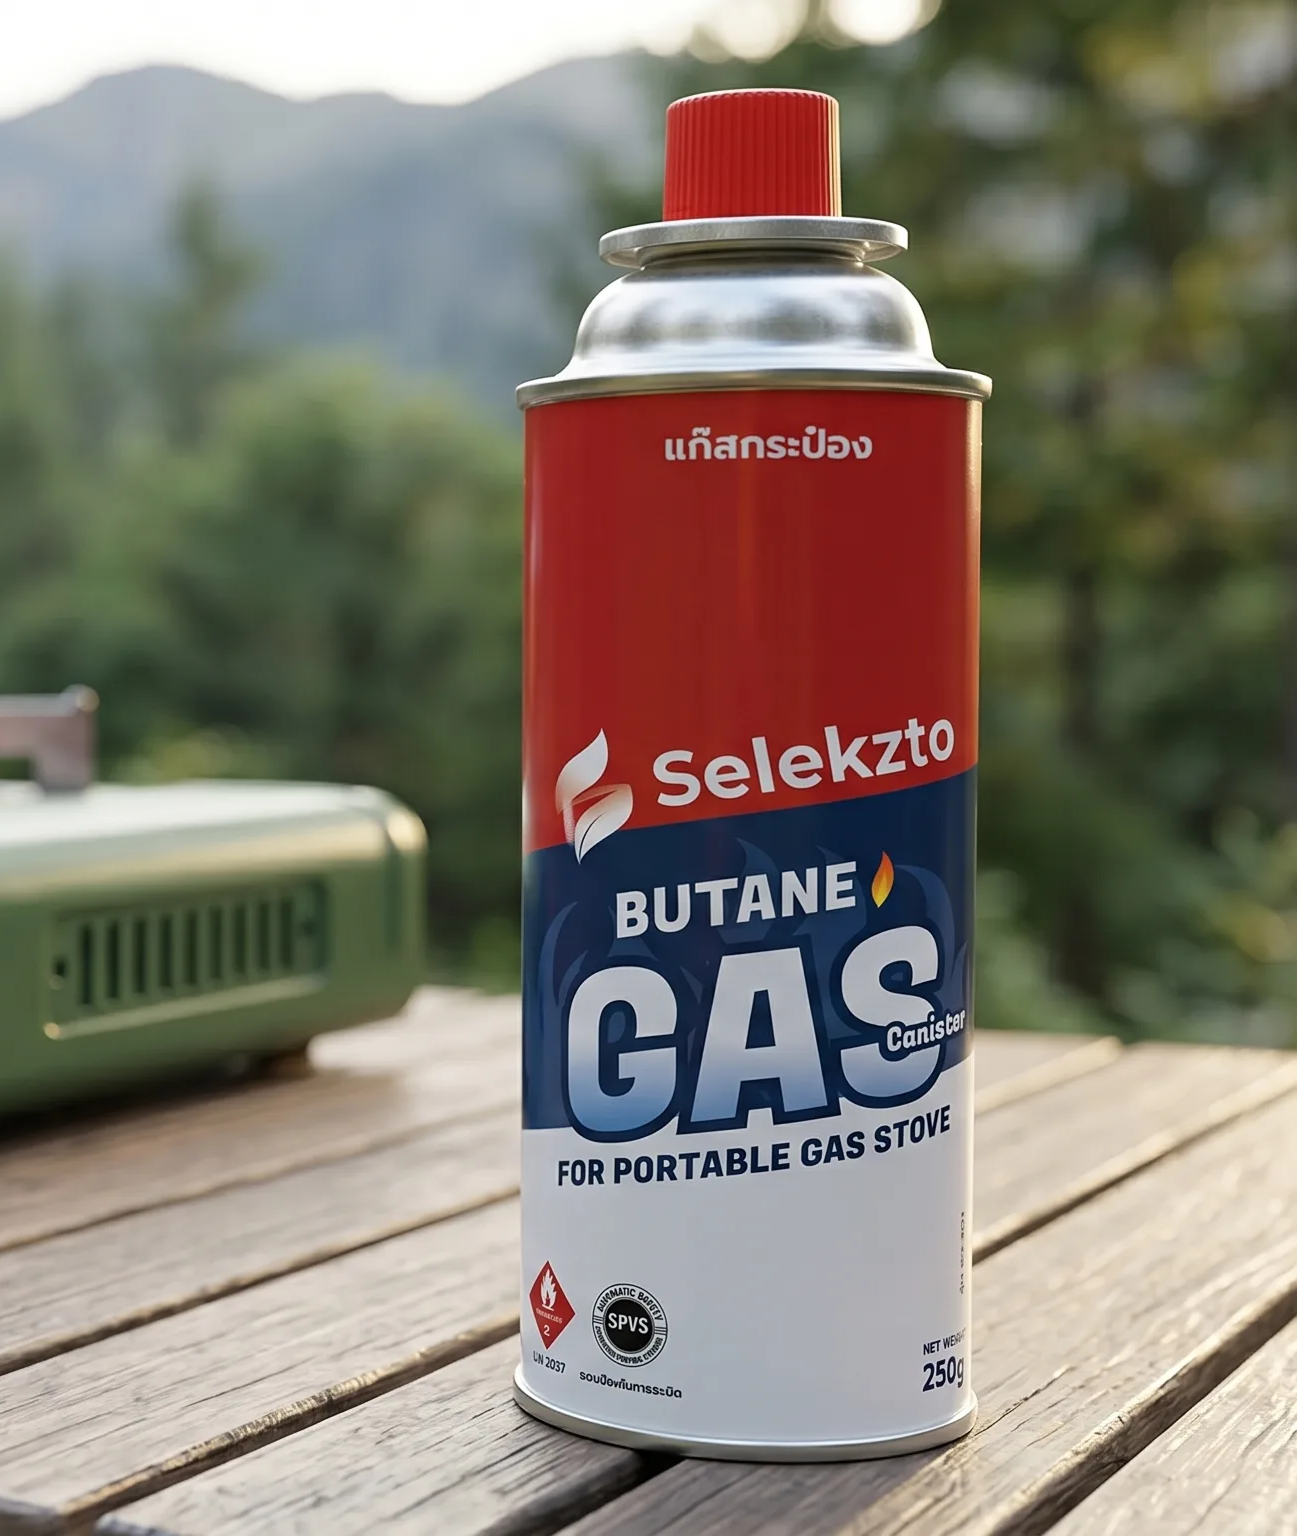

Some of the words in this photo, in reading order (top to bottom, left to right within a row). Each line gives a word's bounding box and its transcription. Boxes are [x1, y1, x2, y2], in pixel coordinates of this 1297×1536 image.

[652, 718, 955, 807] Selekzto
[615, 861, 857, 938] BUTANE
[566, 924, 940, 1134] GAS
[886, 1009, 966, 1052] Canister
[557, 1158, 605, 1187] FOR
[613, 1142, 791, 1184] PORTABLE
[800, 1130, 865, 1168] GAS
[873, 1105, 951, 1154] STOVE
[543, 1324, 550, 1337] 2
[608, 1312, 649, 1334] SPVS
[533, 1350, 544, 1365] UN
[545, 1356, 566, 1374] 2037
[923, 1340, 941, 1356] NET
[922, 1355, 964, 1392] 250g
